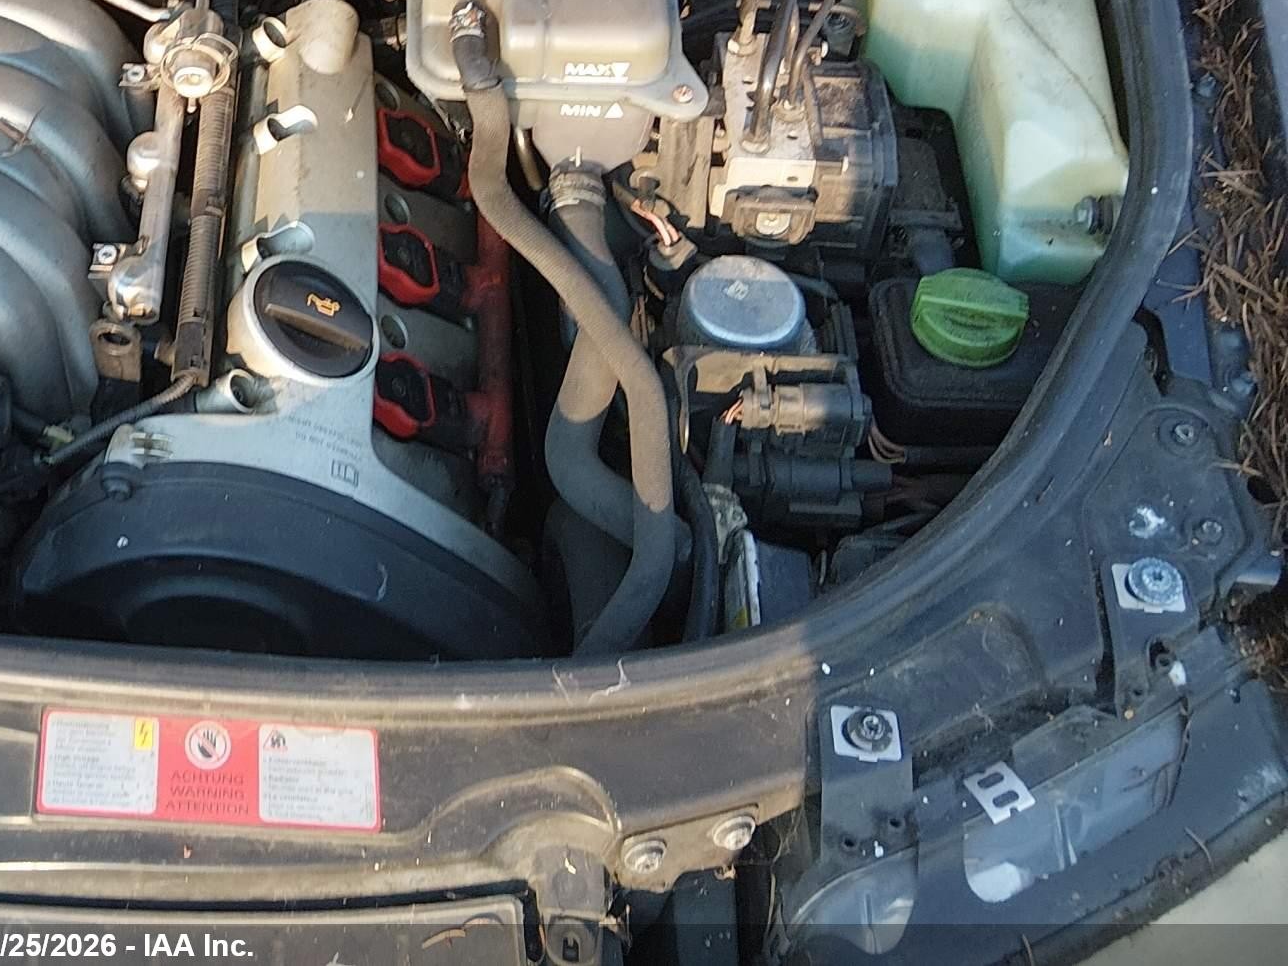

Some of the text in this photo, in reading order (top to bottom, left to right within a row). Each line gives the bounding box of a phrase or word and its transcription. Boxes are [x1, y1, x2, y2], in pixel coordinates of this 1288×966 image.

[564, 62, 612, 76] MAX
[560, 103, 601, 117] MIN
[170, 769, 244, 784] ACHTUNG
[170, 785, 245, 800] WARNING
[165, 799, 249, 815] ATTENTION
